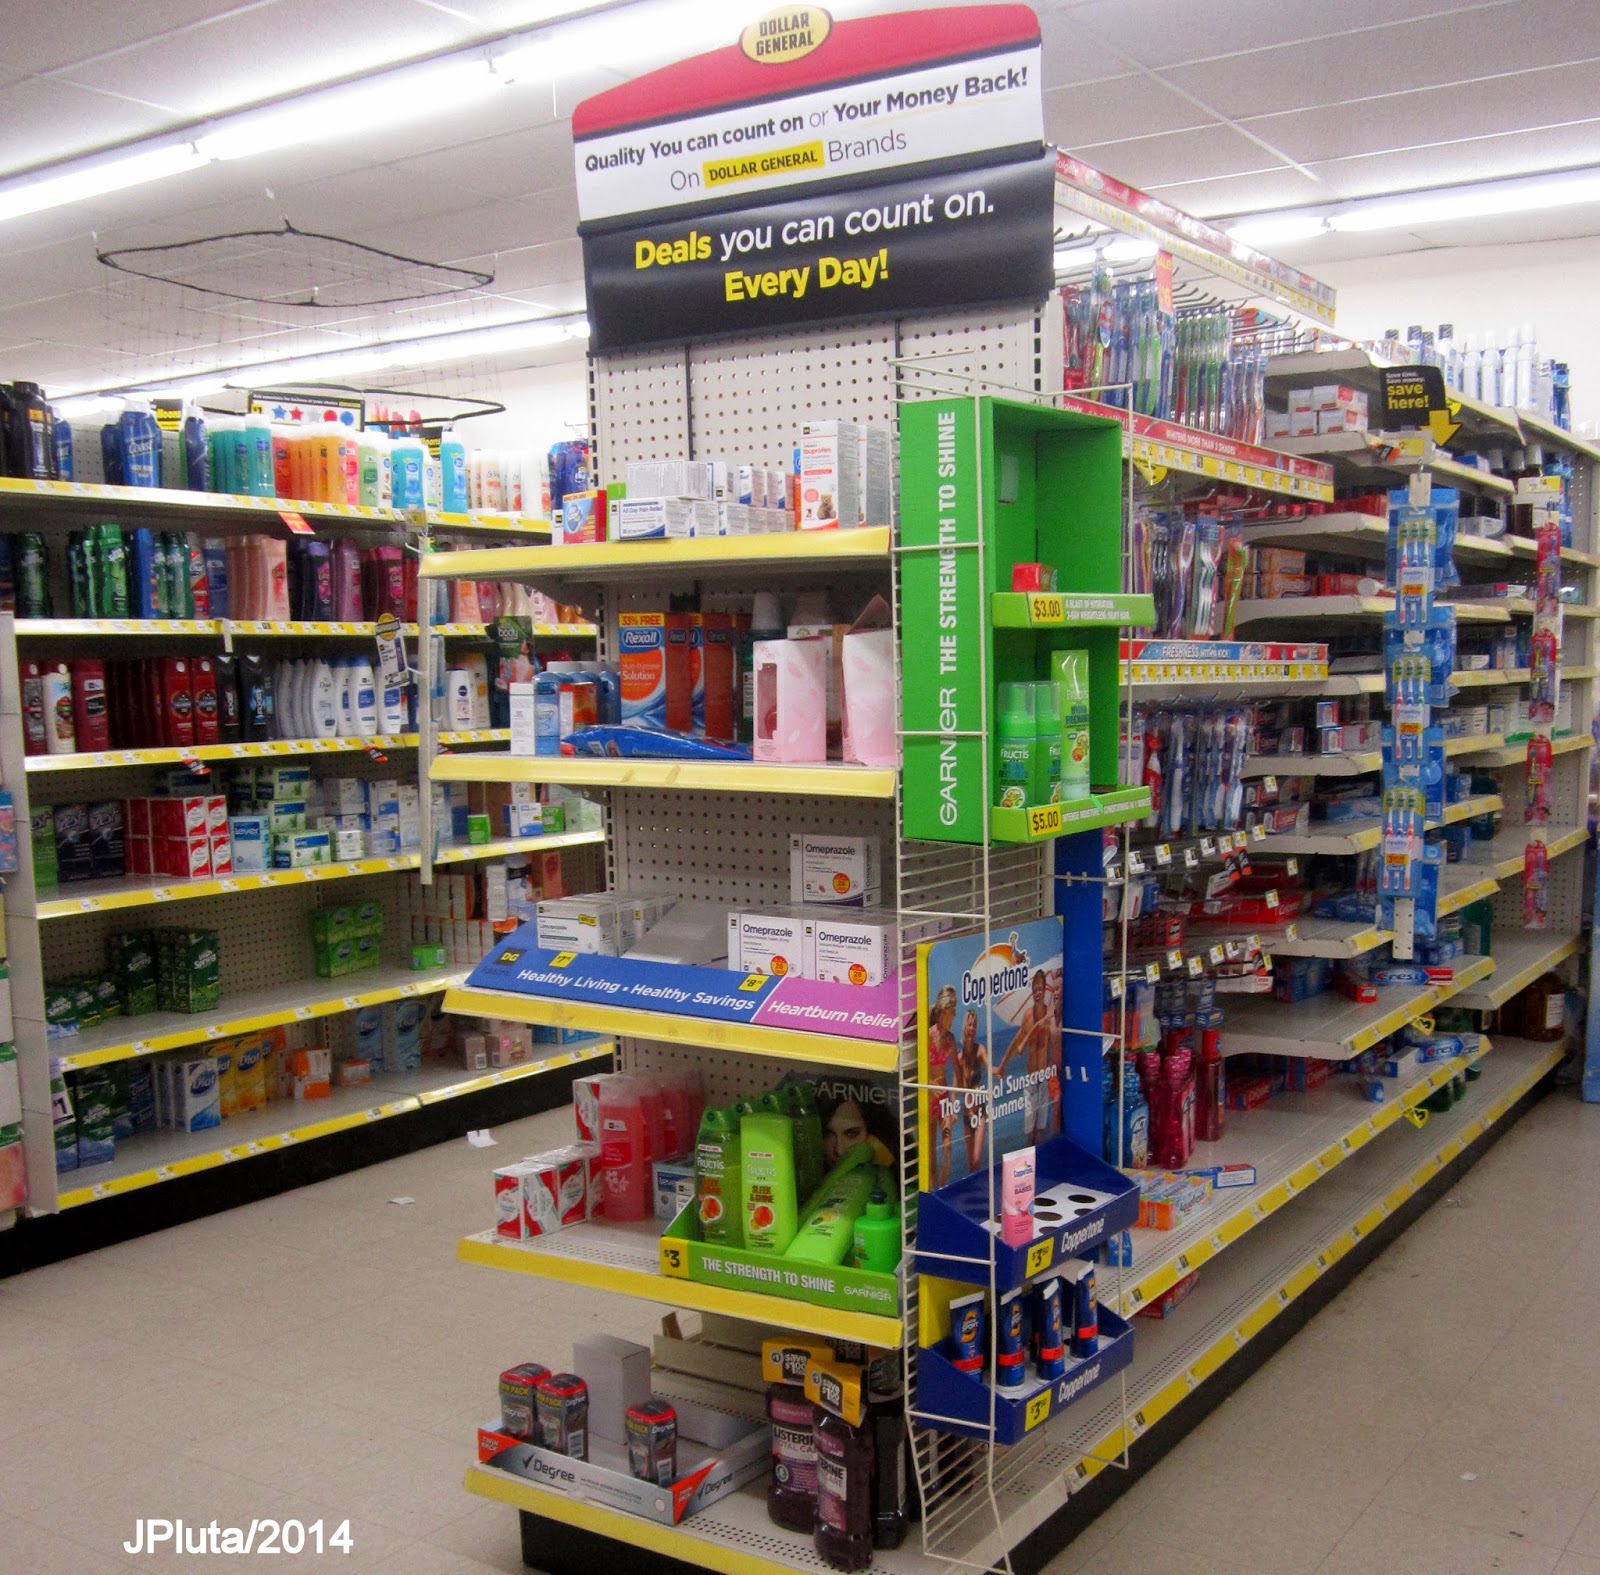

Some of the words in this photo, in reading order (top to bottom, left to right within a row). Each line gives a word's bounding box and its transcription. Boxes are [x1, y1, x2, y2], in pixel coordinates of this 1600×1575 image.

[759, 12, 810, 36] DOLLAR
[755, 30, 815, 56] GENERAL
[585, 146, 645, 172] Quality
[649, 137, 683, 160] You
[686, 133, 718, 152] can
[722, 123, 776, 146] count
[780, 114, 804, 133] on
[808, 110, 830, 129] or
[833, 99, 881, 122] Your
[886, 84, 959, 113] Money
[964, 66, 1028, 96] Back!
[670, 169, 701, 191] On
[709, 161, 758, 182] DOLLAR
[761, 151, 818, 172] GENERAL
[829, 128, 907, 162] Brands
[635, 230, 712, 269] Deals
[720, 226, 772, 262] you
[782, 215, 834, 244] can
[845, 192, 933, 236] count
[944, 189, 994, 218] on.
[725, 264, 809, 302] Every
[819, 248, 888, 291] Day!
[1387, 384, 1423, 396] save
[1388, 394, 1429, 410] here!
[938, 411, 956, 478] SHINE
[939, 484, 956, 512] TO
[939, 519, 956, 629] STRENGTH
[1034, 599, 1060, 619] $3.00
[622, 615, 638, 626] 33%
[640, 615, 661, 625] FREE
[625, 632, 657, 644] Rexall
[939, 635, 957, 675] THE
[622, 671, 655, 680] Solution
[939, 688, 957, 826] GARNIER
[1001, 748, 1029, 759] FRUCTIS
[1032, 810, 1059, 832] $5.00
[805, 843, 856, 856] Omeprazole
[743, 923, 793, 938] Omeprazole
[818, 931, 872, 946] Omeprazole
[501, 952, 519, 962] DG
[517, 969, 574, 987] Healthy
[573, 976, 621, 994] Living
[630, 983, 691, 1004] Healthy
[692, 989, 756, 1011] Savings
[768, 1000, 849, 1024] Heartburn
[852, 1008, 900, 1029] Relief
[191, 1070, 217, 1090] Dial
[940, 1098, 960, 1119] The
[964, 1083, 1003, 1110] Offical
[1006, 1064, 1058, 1092] Sunscreen
[970, 1110, 984, 1129] of
[697, 1156, 725, 1170] FRUCTIS
[751, 1185, 771, 1195] SLEEK
[1014, 1184, 1032, 1195] BABIES
[1060, 1215, 1106, 1253] Coppertone
[664, 1248, 681, 1268] $3
[701, 1256, 719, 1271] THE
[725, 1259, 780, 1285] STRENGTH
[784, 1270, 798, 1287] TO
[800, 1274, 836, 1294] SHINE
[843, 1284, 892, 1302] GARNIER
[785, 1353, 808, 1364] save
[822, 1378, 840, 1392] save
[1059, 1363, 1101, 1403] Coppertone
[652, 1422, 675, 1434] Degree
[533, 1459, 575, 1480] Degree
[705, 1473, 734, 1496] Degree
